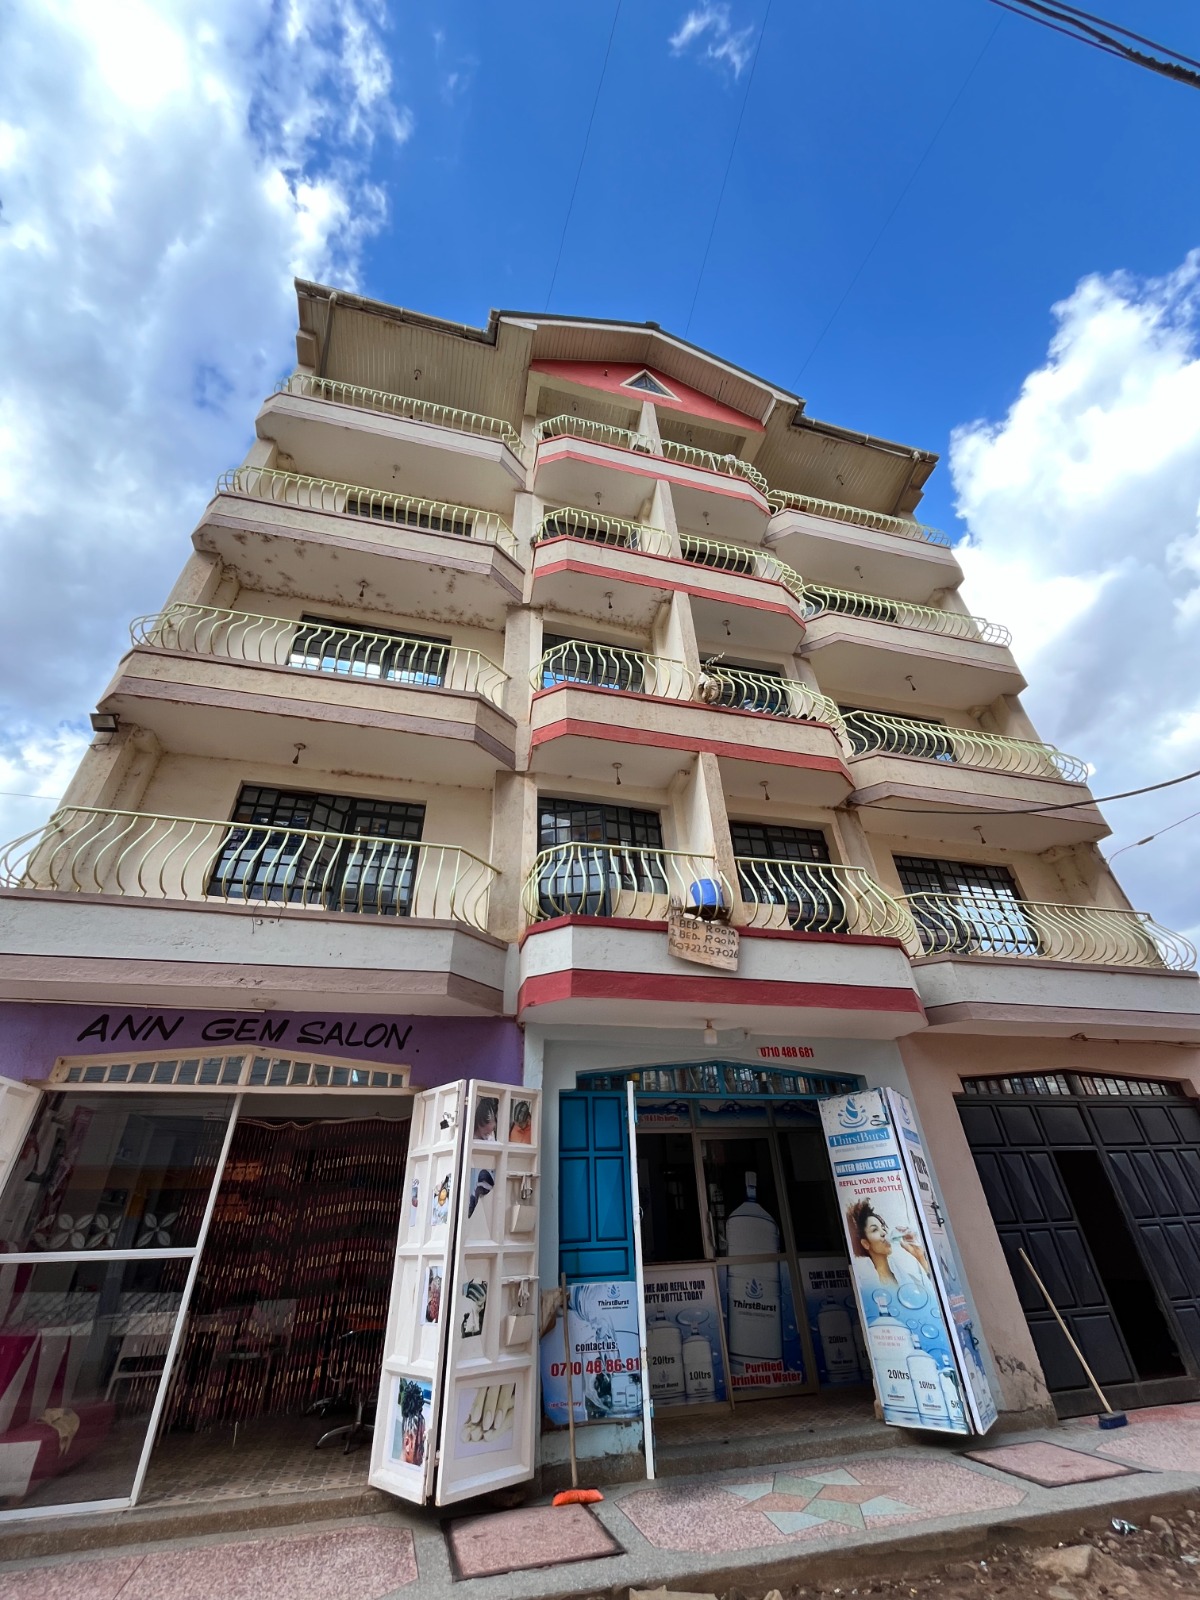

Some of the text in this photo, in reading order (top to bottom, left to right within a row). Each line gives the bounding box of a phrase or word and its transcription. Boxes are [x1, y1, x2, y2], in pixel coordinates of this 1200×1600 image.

[671, 928, 677, 937] 2
[705, 935, 736, 946] ROOM
[706, 925, 736, 938] ROOM
[77, 1013, 184, 1042] ANN
[201, 1018, 290, 1042] GEM
[781, 1046, 798, 1058] 488
[798, 1046, 815, 1058] 681
[829, 1130, 889, 1146] ThirstBurst
[835, 1164, 855, 1174] WATER
[874, 1159, 896, 1169] CENTER
[656, 1282, 669, 1292] AND
[670, 1281, 688, 1291] REFILL
[688, 1280, 706, 1290] YOUR
[660, 1291, 683, 1302] BOTTLE
[683, 1290, 703, 1301] TODAY
[597, 1299, 630, 1307] ThirstBurst
[733, 1299, 777, 1312] ThirstBurst
[575, 1342, 605, 1352] contact
[585, 1360, 602, 1374] 48
[652, 1356, 675, 1366] 20ltrs
[745, 1361, 783, 1373] Purified
[689, 1371, 712, 1380] 10ltrs
[731, 1372, 801, 1386] Drinking Water
[887, 1369, 910, 1380] 20ltrs
